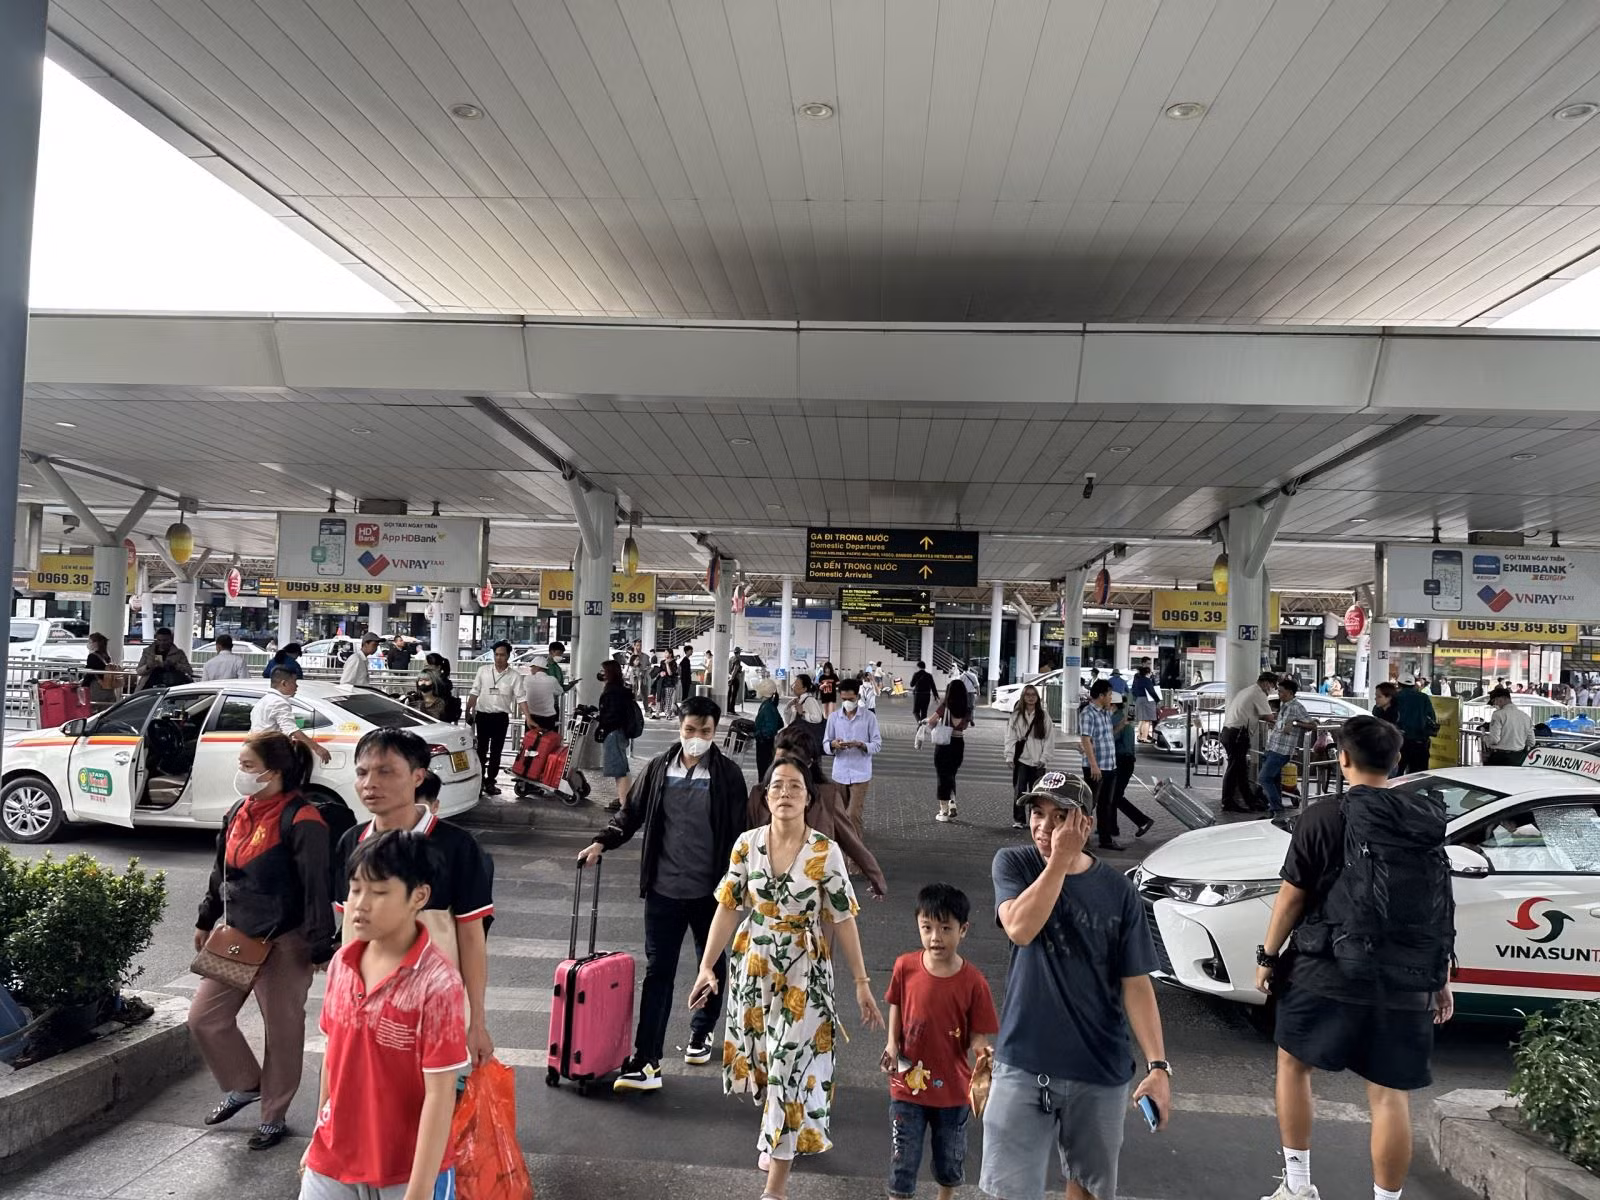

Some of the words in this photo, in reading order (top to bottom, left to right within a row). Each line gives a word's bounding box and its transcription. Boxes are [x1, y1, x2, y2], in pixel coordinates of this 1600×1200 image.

[382, 534, 400, 543] App
[401, 535, 437, 543] HDBank
[865, 533, 889, 542] NƯỚC
[392, 559, 430, 569] VNPAY
[824, 560, 840, 569] ĐẾN
[874, 562, 898, 571] NƯỚC
[1502, 564, 1566, 574] EXIMBANK
[1515, 593, 1558, 604] VNPAY
[585, 602, 602, 614] C-14
[1240, 626, 1258, 640] C-13
[1457, 621, 1567, 634] 0969.39.89.89
